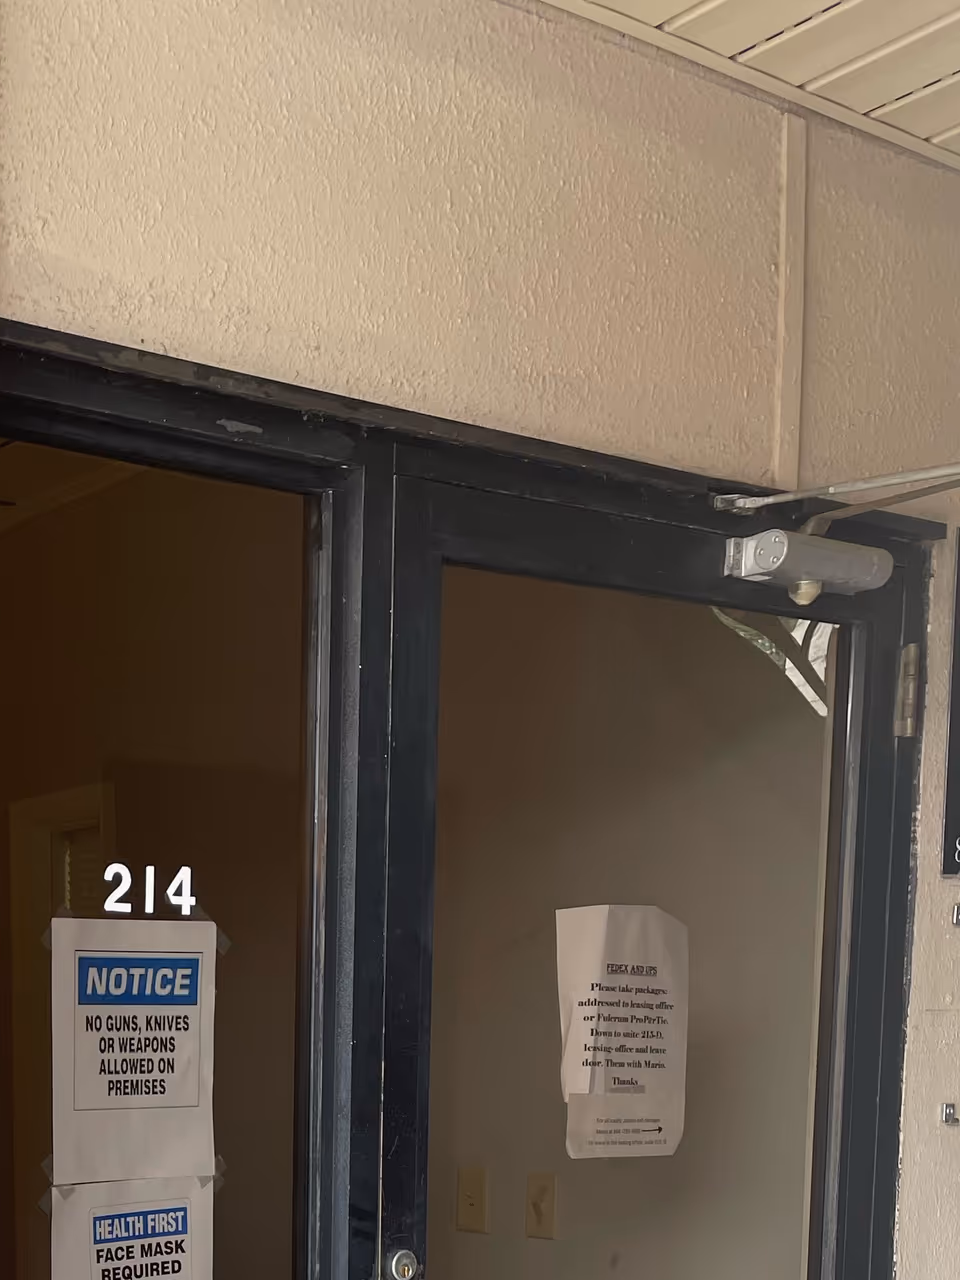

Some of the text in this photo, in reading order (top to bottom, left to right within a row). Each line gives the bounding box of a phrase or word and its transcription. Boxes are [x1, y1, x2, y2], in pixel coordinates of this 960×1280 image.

[104, 863, 196, 915] 214
[607, 963, 657, 975] FEDEX AND UPS
[86, 967, 192, 996] NOTICE
[590, 983, 617, 993] Please
[618, 984, 633, 993] take
[578, 998, 674, 1010] addressed to leasing office
[85, 1015, 190, 1034] NO GUNS, KNIVES
[597, 1013, 628, 1023] Fulcrum
[590, 1028, 612, 1038] Down
[614, 1030, 621, 1038] to
[98, 1037, 176, 1053] OR WEAPONS
[615, 1044, 634, 1053] office
[635, 1045, 648, 1053] and
[99, 1058, 175, 1075] ALLOWED ON
[626, 1060, 642, 1068] with
[107, 1079, 166, 1096] PREMISES
[95, 1211, 184, 1240] HEALTH FIRST
[96, 1239, 186, 1263] FACE MASK
